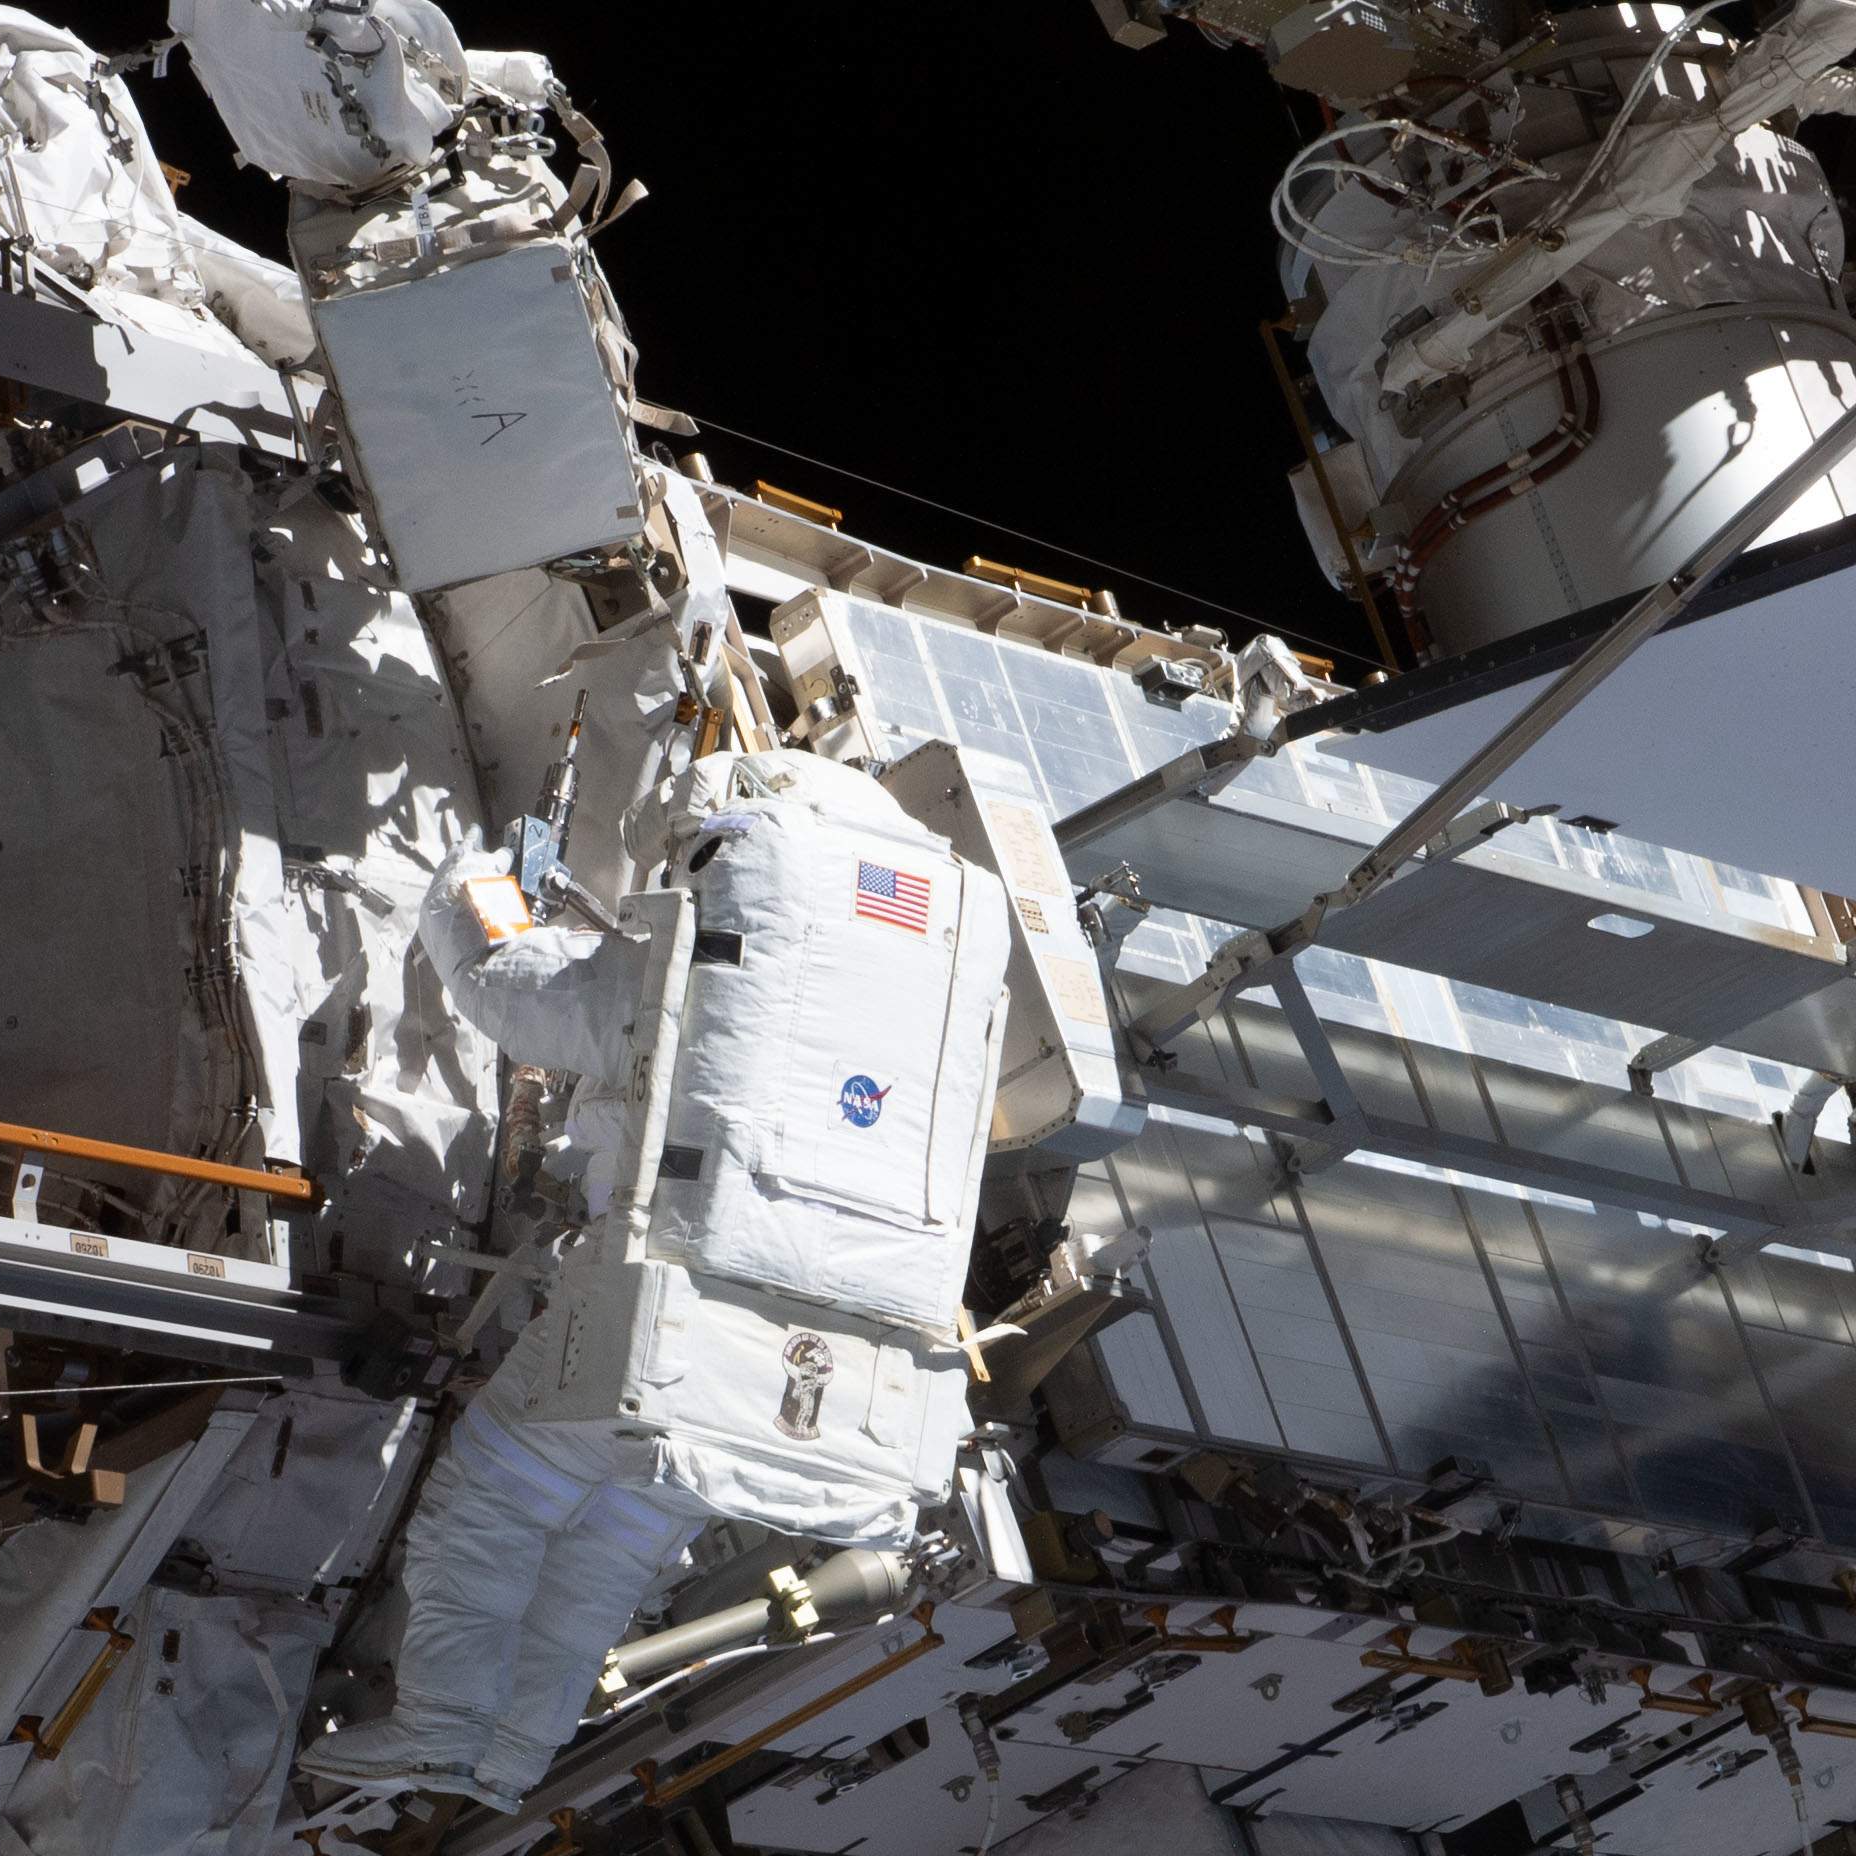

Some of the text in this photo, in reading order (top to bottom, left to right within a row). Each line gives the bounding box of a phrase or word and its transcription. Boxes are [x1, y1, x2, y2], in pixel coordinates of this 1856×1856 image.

[471, 412, 528, 446] A
[76, 1242, 103, 1256] 10260
[193, 1263, 220, 1277] 10290
